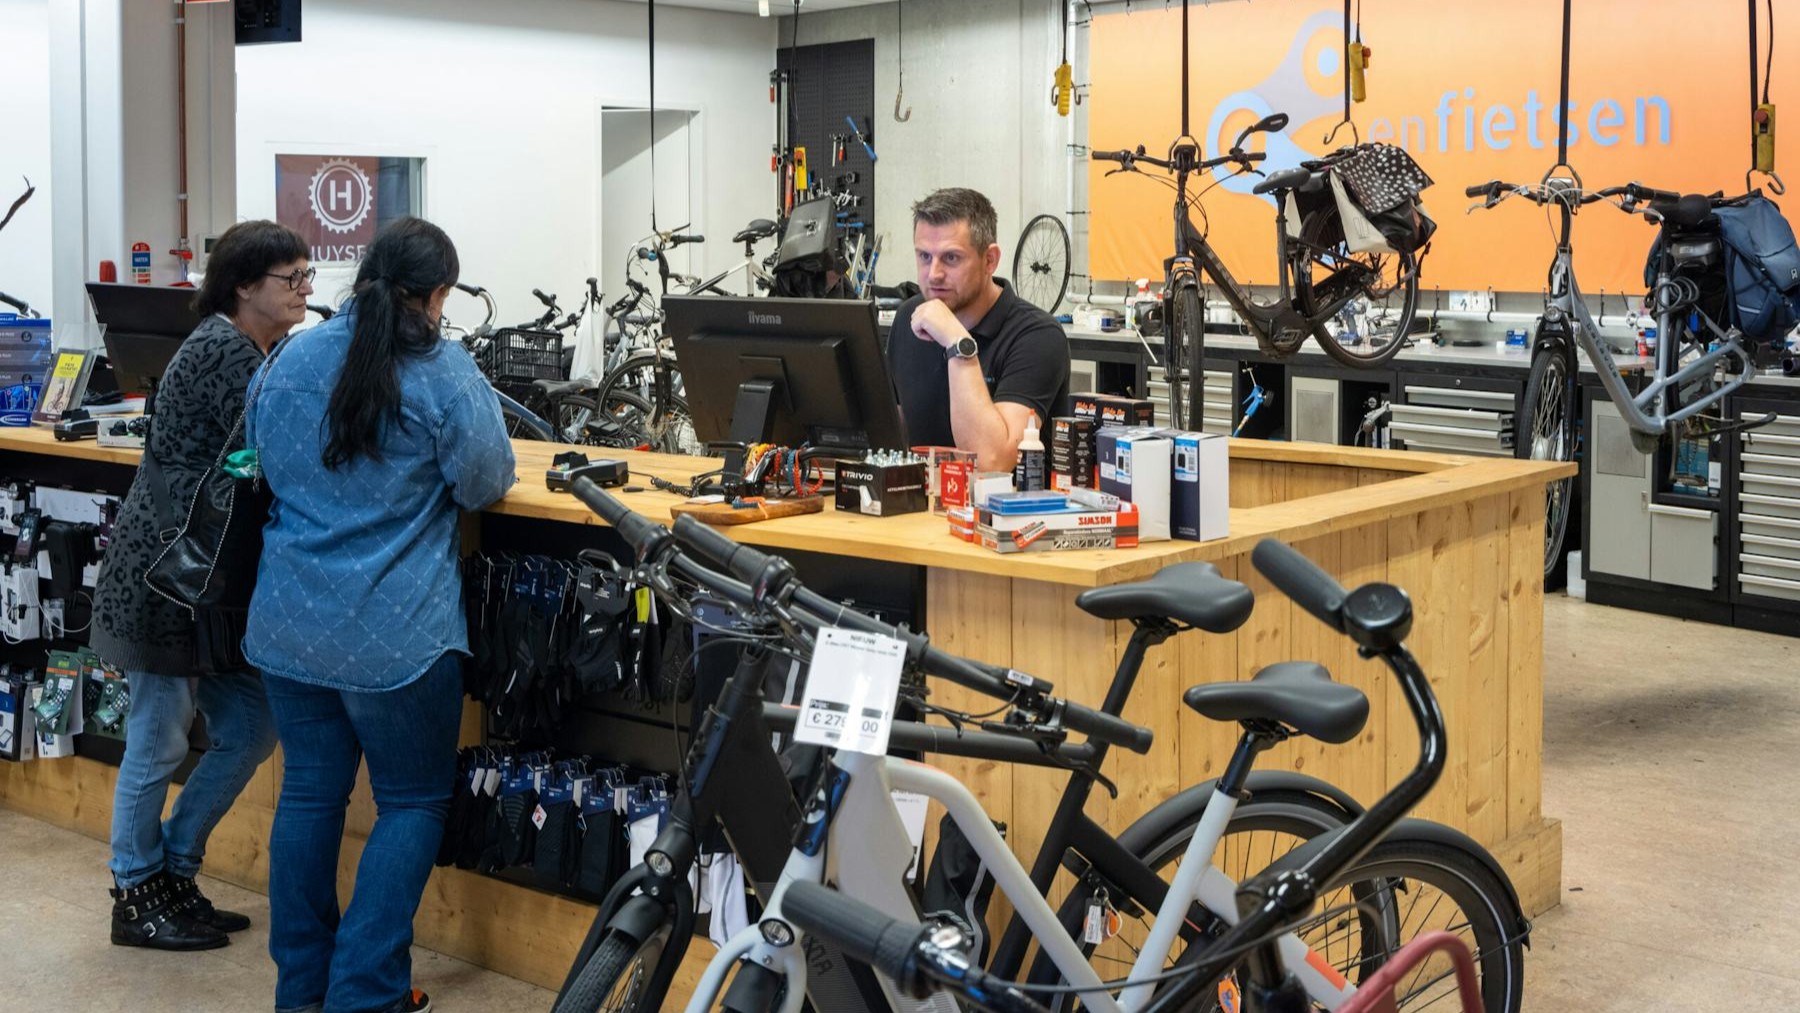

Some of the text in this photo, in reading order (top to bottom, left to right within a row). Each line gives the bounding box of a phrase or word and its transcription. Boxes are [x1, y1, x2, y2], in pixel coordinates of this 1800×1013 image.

[328, 179, 352, 211] H
[846, 470, 874, 482] TRIVIO
[1078, 515, 1112, 526] SIMSON
